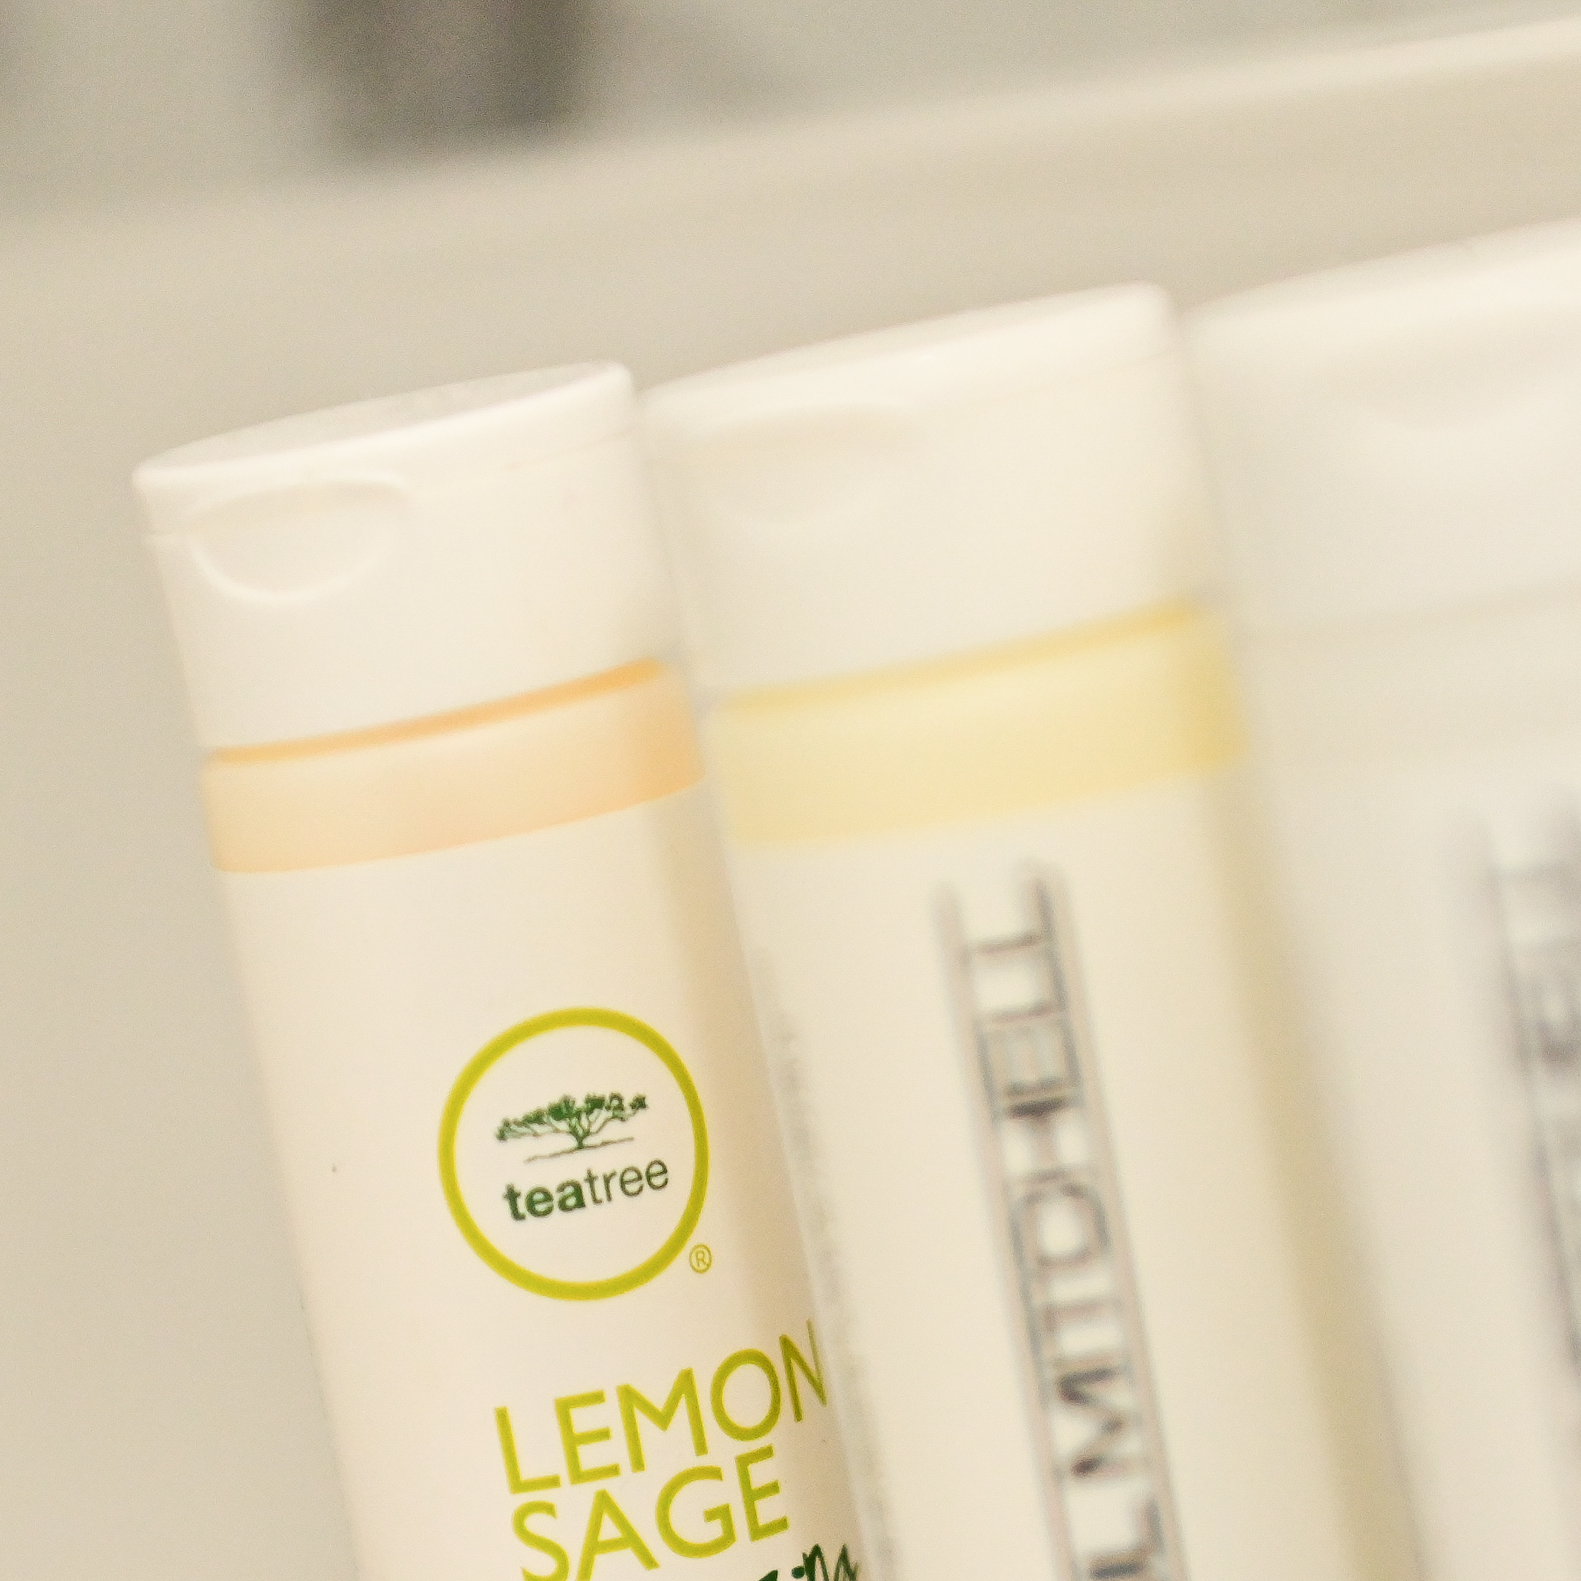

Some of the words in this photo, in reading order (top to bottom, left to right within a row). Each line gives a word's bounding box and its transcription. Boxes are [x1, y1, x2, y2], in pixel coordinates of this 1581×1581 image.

[502, 1157, 670, 1222] teatree
[963, 876, 1147, 1482] MITCHELL
[493, 1317, 828, 1496] LEMON
